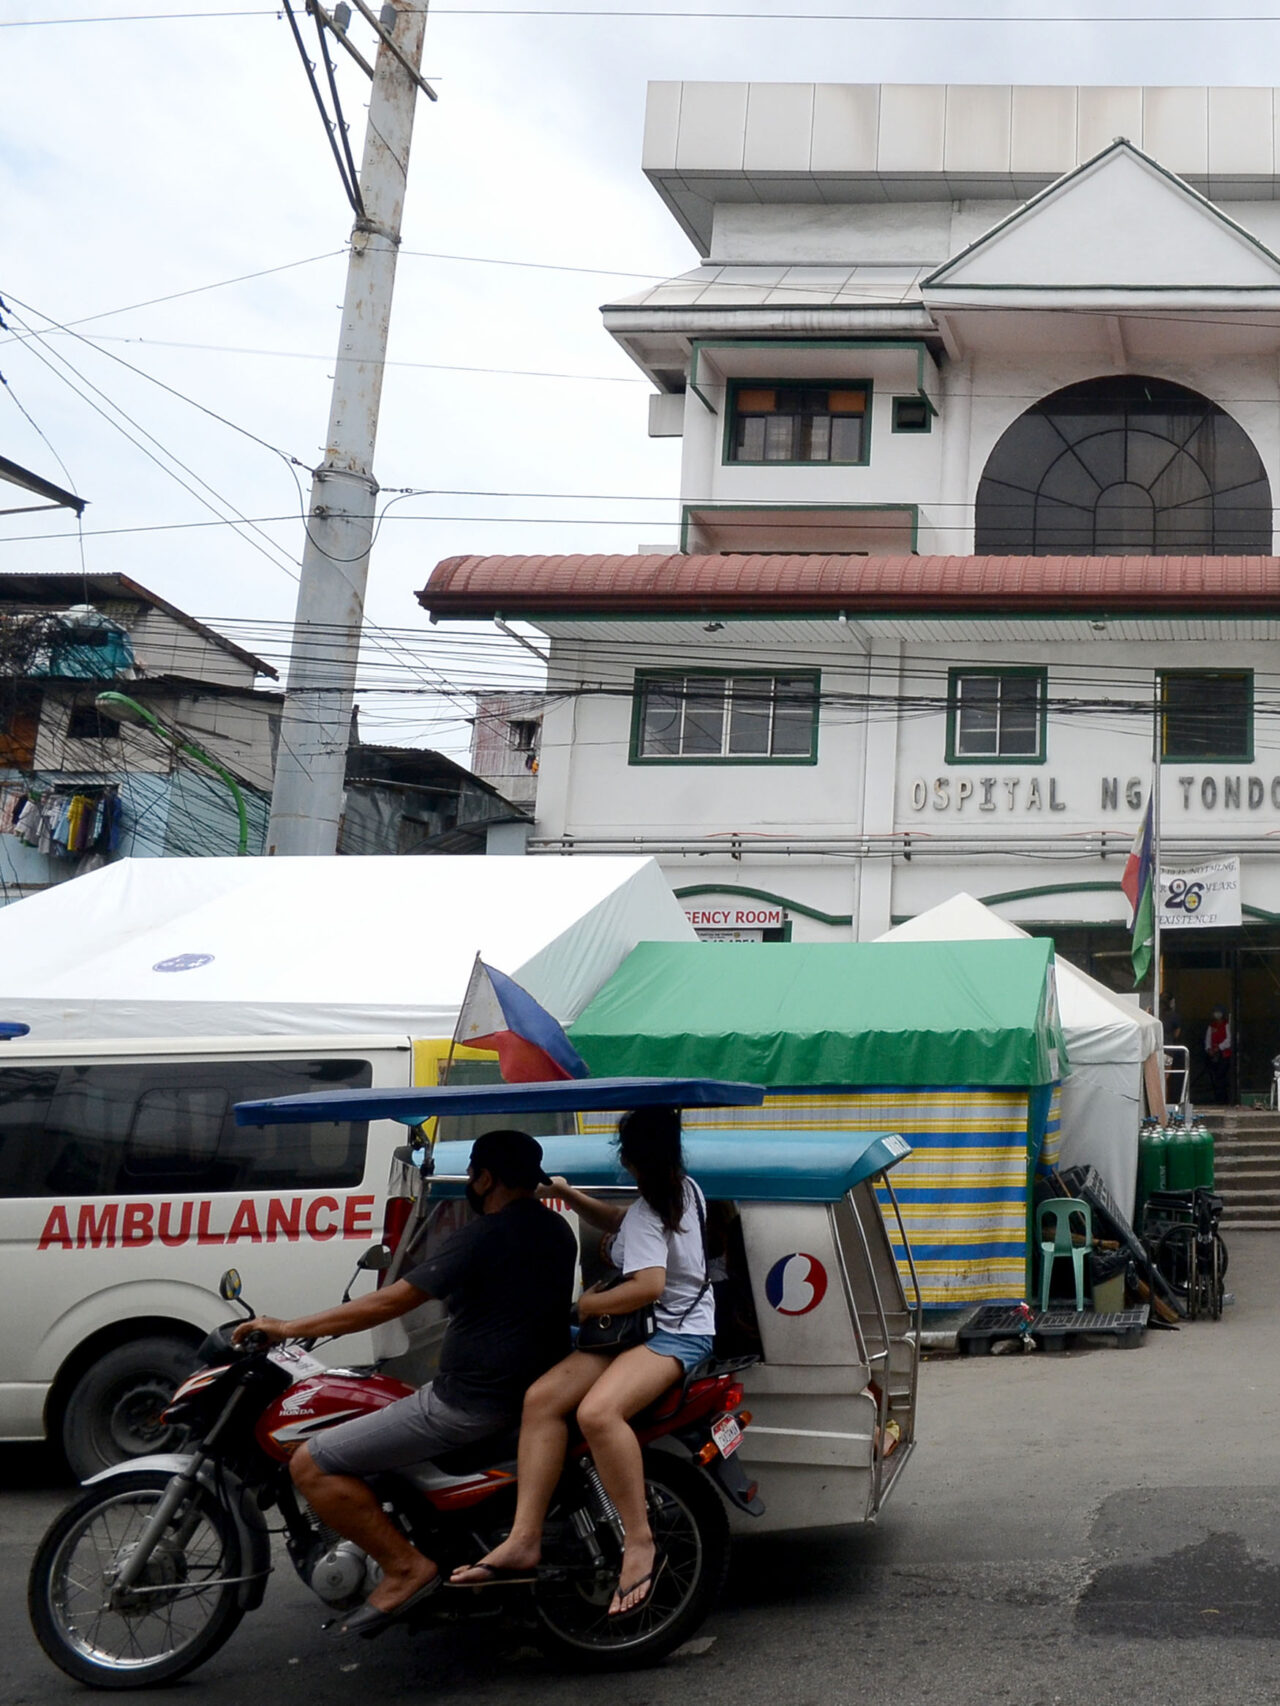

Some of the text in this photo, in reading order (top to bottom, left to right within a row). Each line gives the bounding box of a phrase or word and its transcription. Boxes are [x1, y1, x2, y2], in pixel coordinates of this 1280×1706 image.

[911, 776, 1066, 812] OSPITAL
[1101, 776, 1142, 811] NG
[1165, 879, 1237, 913] 26 YEARS
[735, 911, 780, 924] ROOM
[37, 1195, 376, 1250] AMBULANCE
[279, 1408, 315, 1416] HONDA
